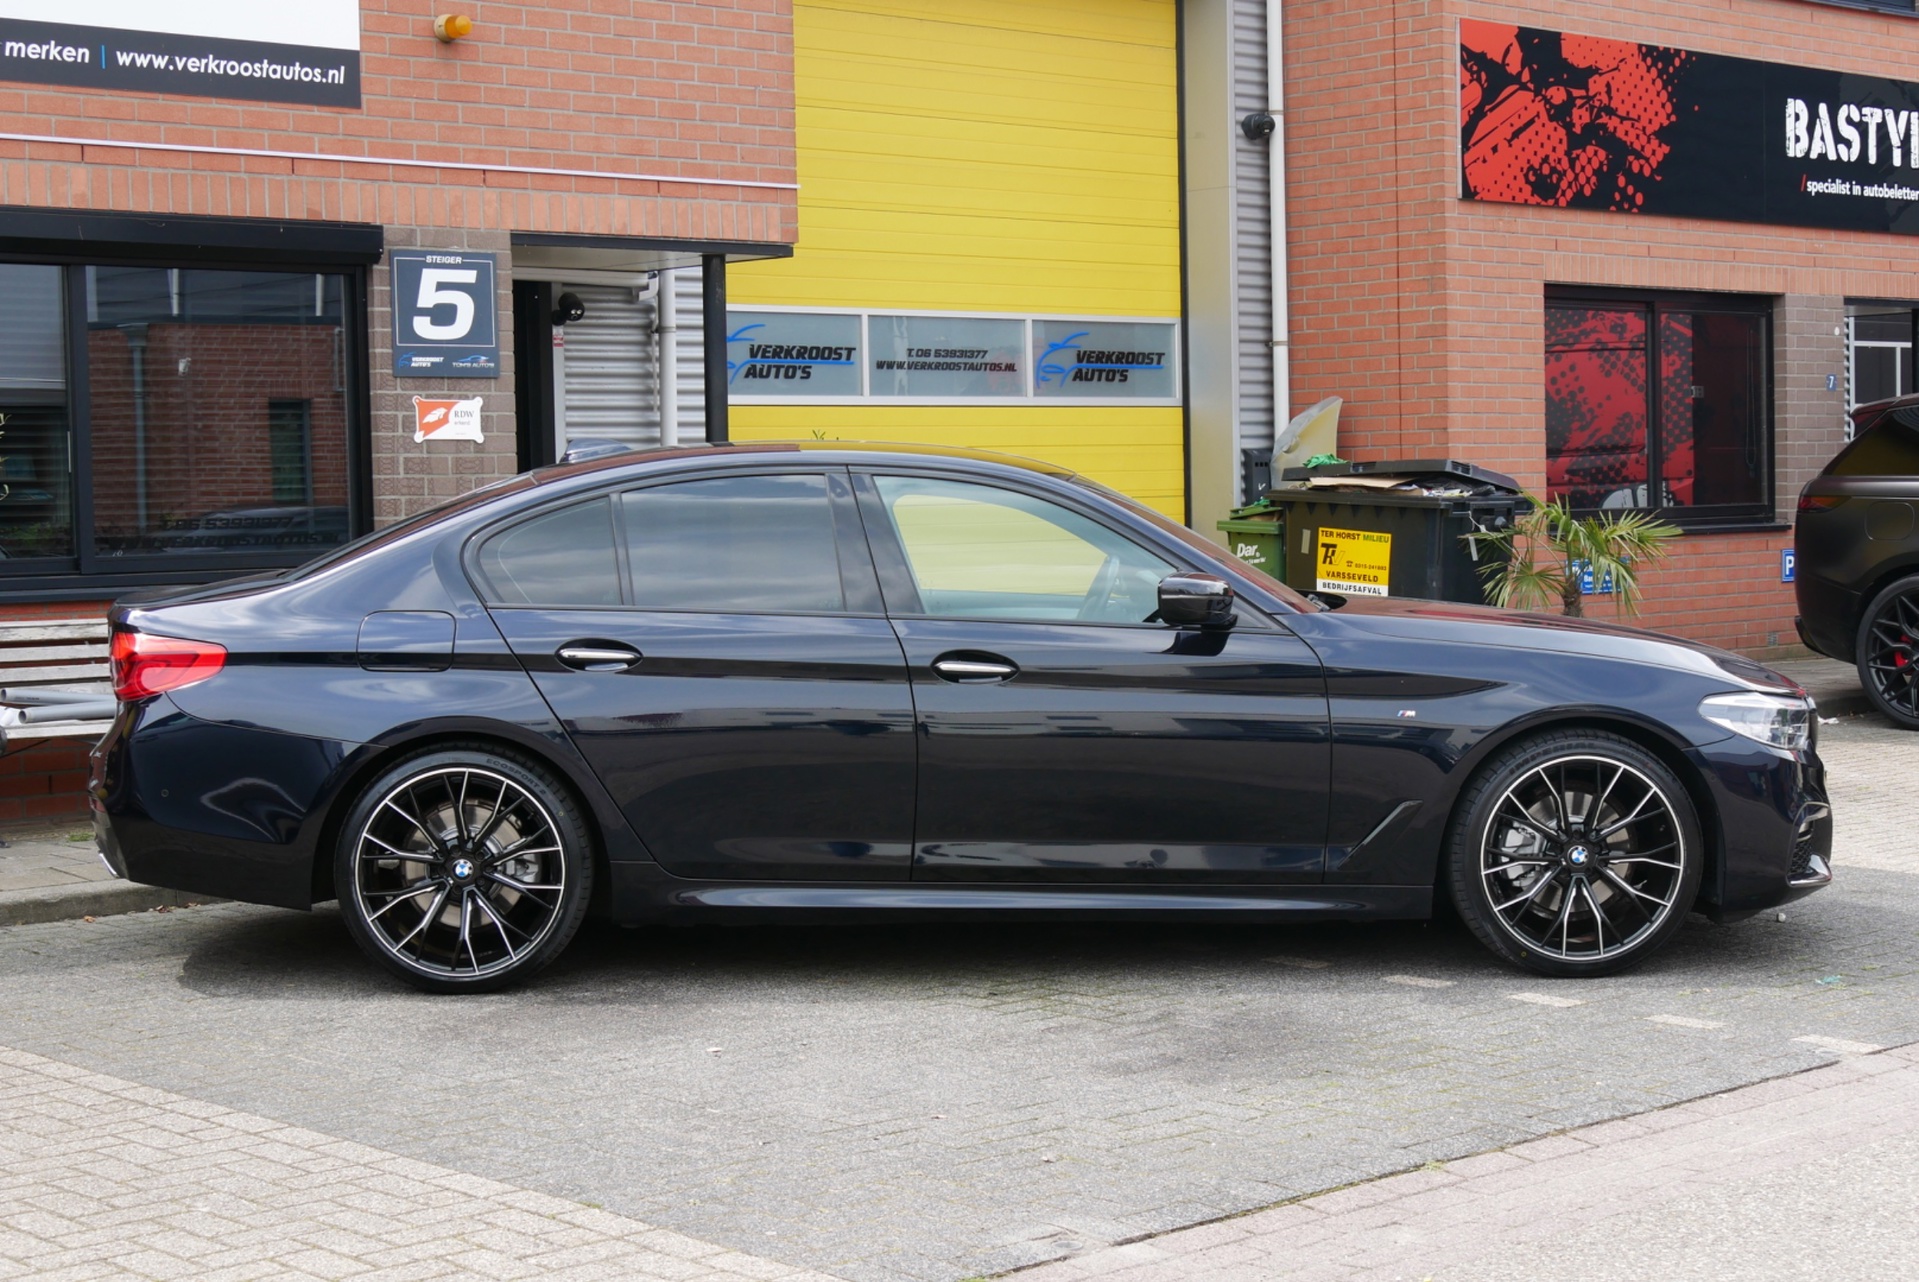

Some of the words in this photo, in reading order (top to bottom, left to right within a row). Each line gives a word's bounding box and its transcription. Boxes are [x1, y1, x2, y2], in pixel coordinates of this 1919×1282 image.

[5, 40, 90, 63] merken
[116, 51, 345, 84] www.verkroostautos.nl
[1852, 181, 1861, 195] in
[426, 255, 463, 264] STEIGER
[413, 268, 477, 340] 5
[749, 344, 856, 361] VERKROOST
[934, 349, 988, 359] 53931377
[1076, 350, 1165, 365] VERKROOST
[744, 364, 812, 379] AUTO'S
[876, 360, 1017, 372] WWW.VERKROOSTAUTOS.NL
[1072, 368, 1128, 382] AUTO'S
[1829, 375, 1835, 389] 7
[1321, 530, 1334, 538] TER
[1336, 532, 1361, 540] HORST
[1363, 534, 1390, 543] MILIEU
[1326, 570, 1379, 583] VARSSEVELD
[1322, 582, 1382, 595] BEDRIJFSAFVAL
